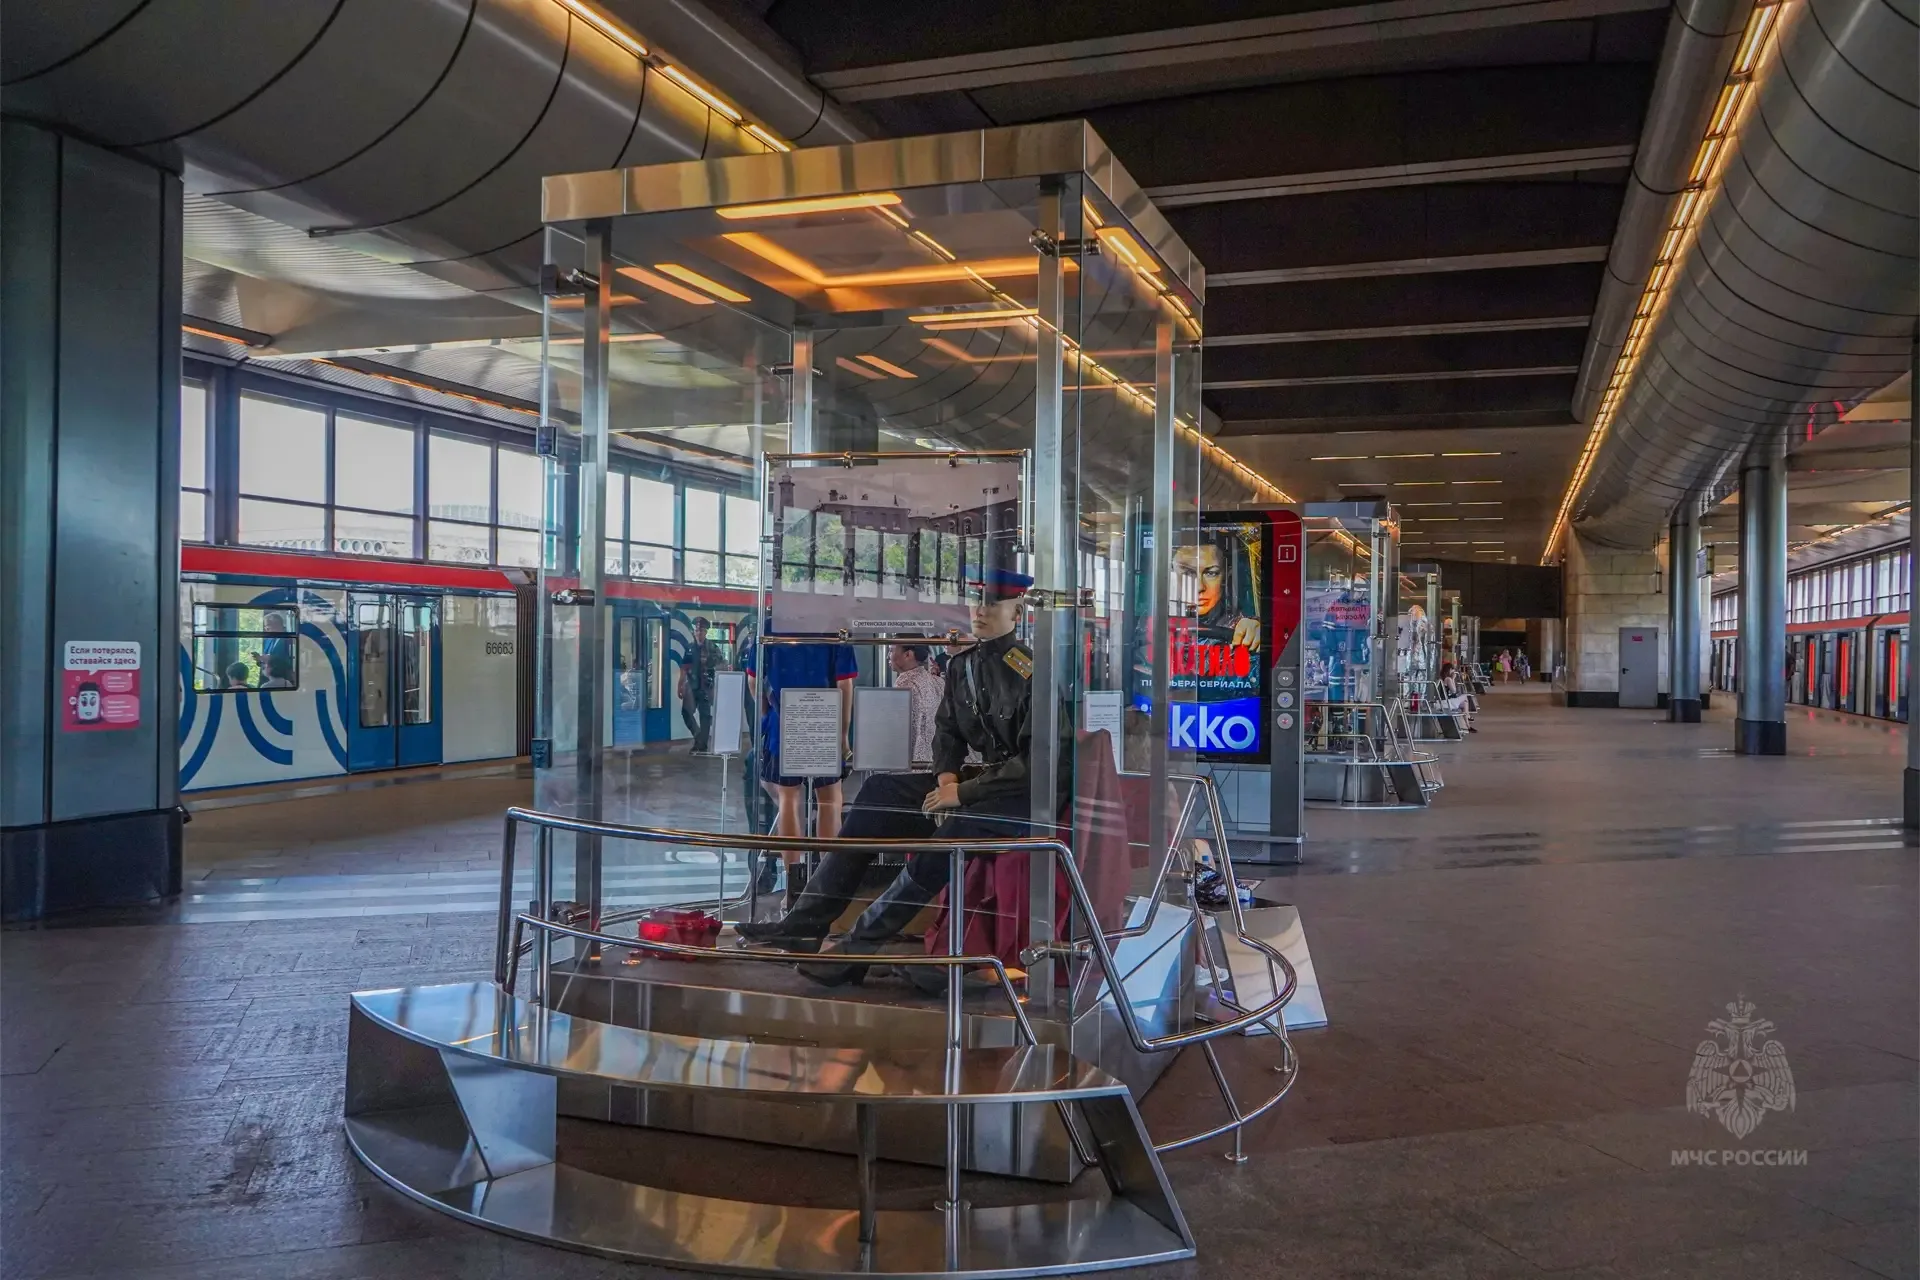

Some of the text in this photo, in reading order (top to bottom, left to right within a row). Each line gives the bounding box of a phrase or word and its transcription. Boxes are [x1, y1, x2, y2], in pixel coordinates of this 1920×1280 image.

[853, 620, 887, 628] Сретенская
[70, 646, 137, 656] Если потерялся,
[486, 642, 514, 655] 66663
[69, 656, 137, 666] оставайся здесь
[1199, 680, 1253, 689] СЕРИАЛА
[1171, 704, 1256, 750] kko
